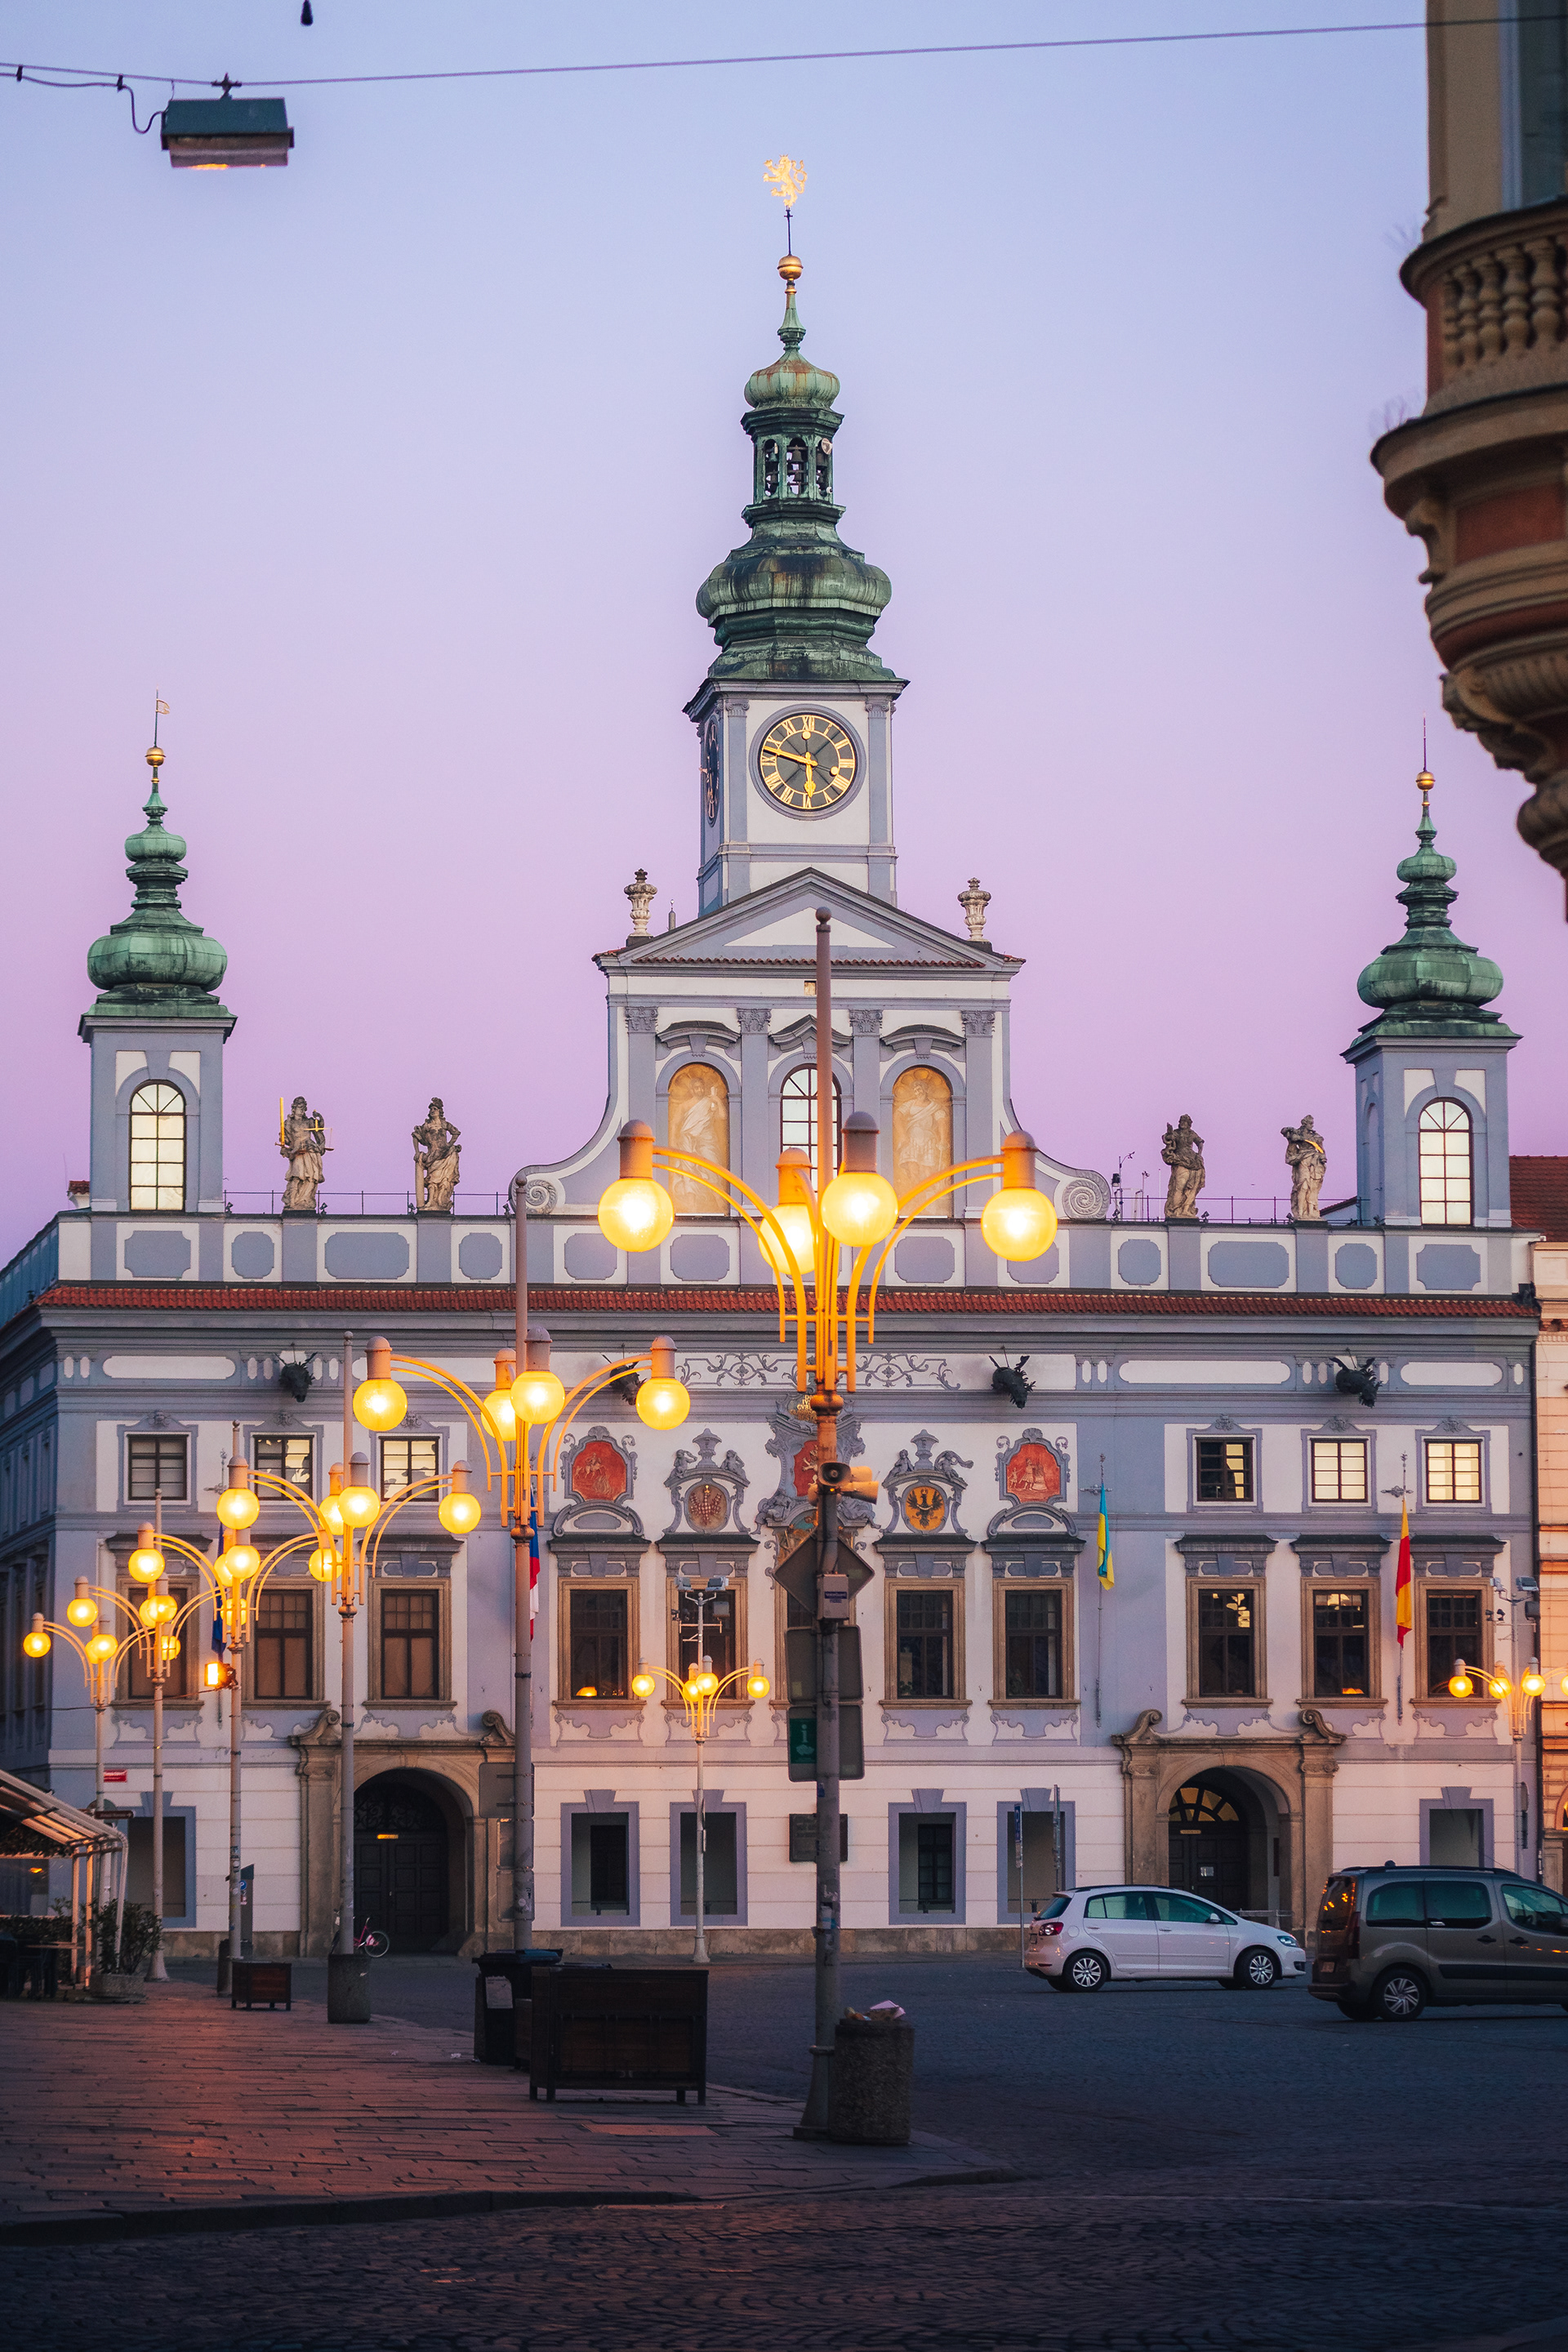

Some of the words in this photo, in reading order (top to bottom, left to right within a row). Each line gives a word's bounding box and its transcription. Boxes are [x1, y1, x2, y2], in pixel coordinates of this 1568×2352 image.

[781, 719, 796, 736] XI
[802, 716, 815, 732] XII
[823, 722, 833, 735] I
[766, 736, 782, 749] X
[835, 738, 849, 750] II
[840, 759, 853, 768] III
[823, 791, 833, 804] V
